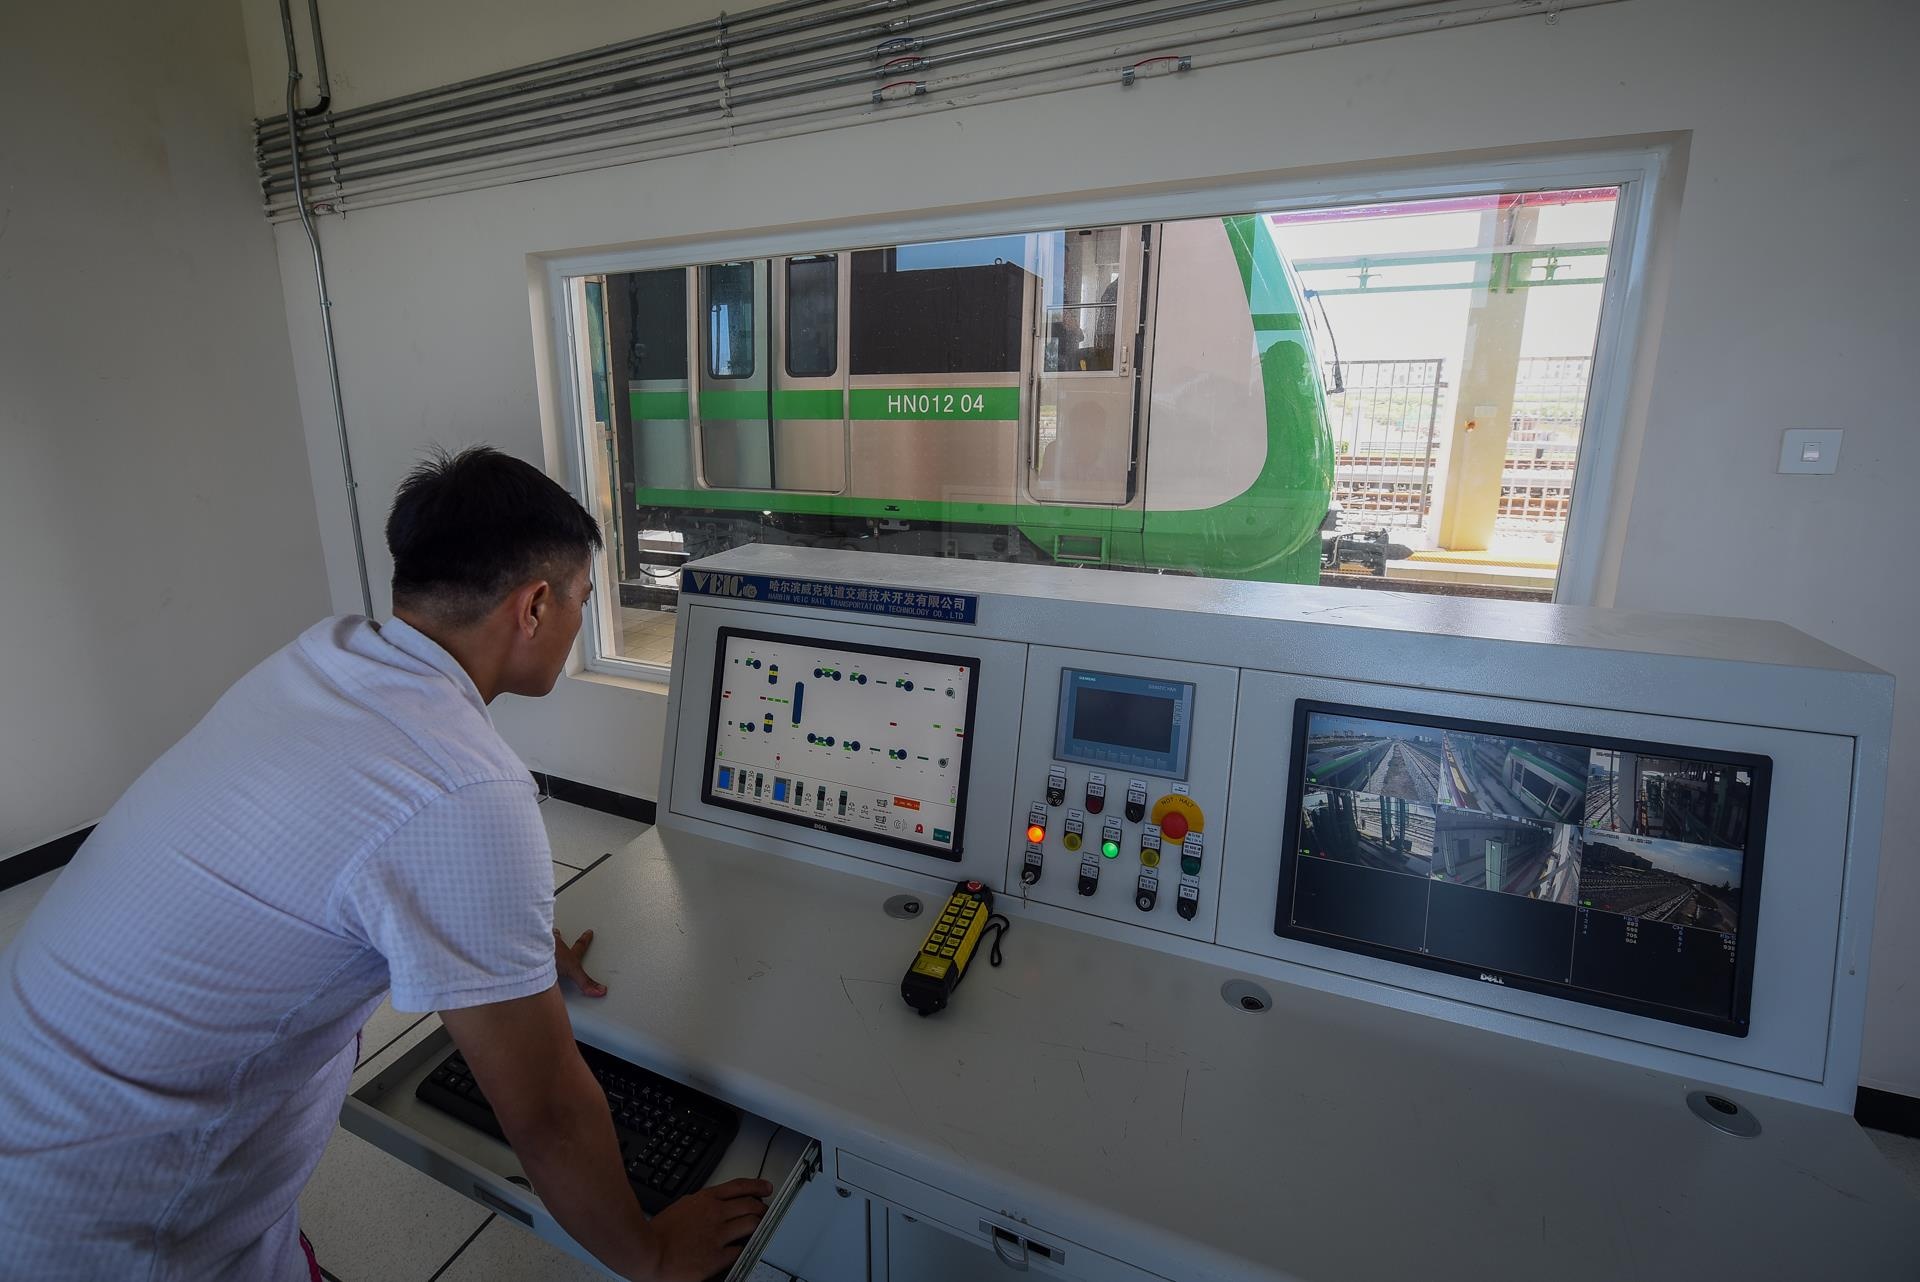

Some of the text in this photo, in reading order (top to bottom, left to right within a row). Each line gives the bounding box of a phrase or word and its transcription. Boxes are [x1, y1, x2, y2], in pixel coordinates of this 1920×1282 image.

[888, 394, 984, 413] HN012 04
[768, 580, 966, 611] 哈尔滨威克轨道交通技术开发有限公司
[888, 604, 930, 617] TECHNOLOGY
[1480, 973, 1505, 985] DELL
